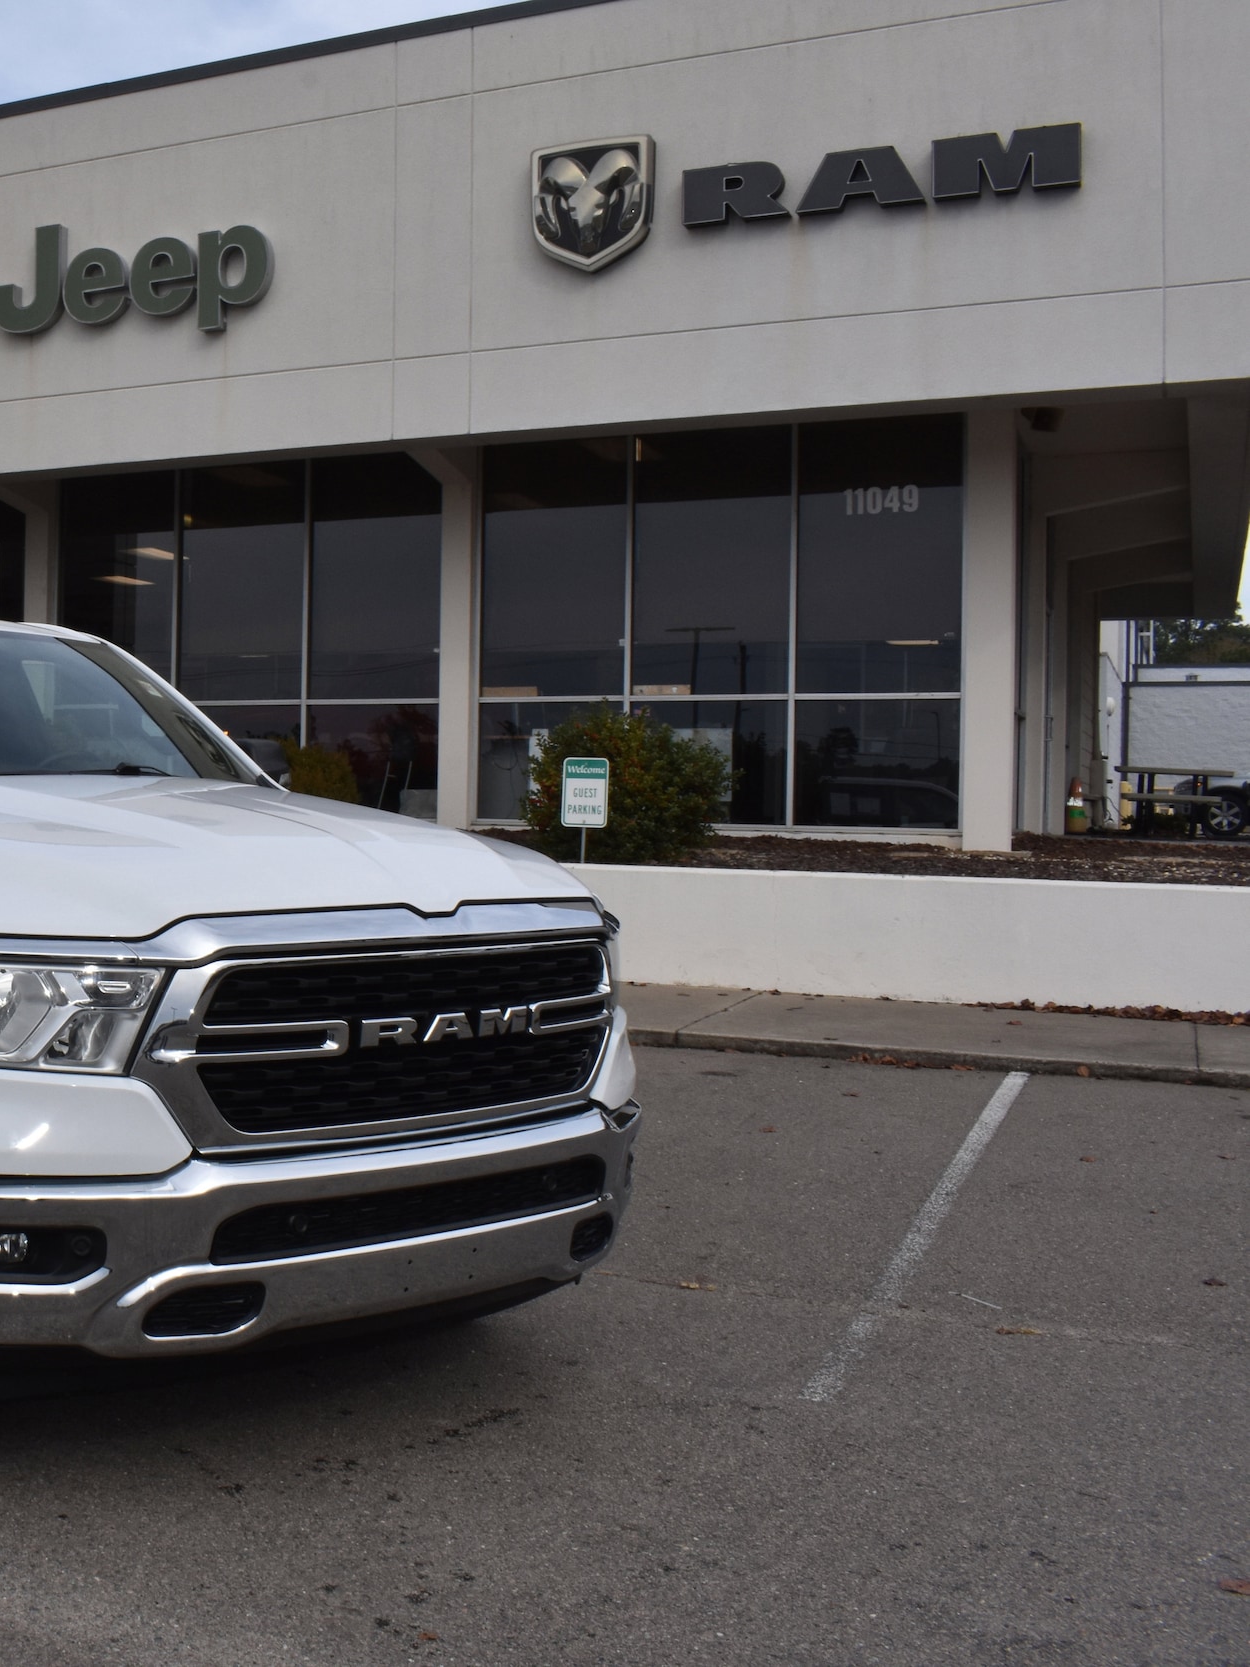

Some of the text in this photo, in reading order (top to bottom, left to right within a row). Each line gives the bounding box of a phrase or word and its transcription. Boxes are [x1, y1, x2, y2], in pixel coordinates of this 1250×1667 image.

[682, 122, 1082, 228] RAM
[843, 484, 919, 516] 11049
[567, 763, 606, 775] Welcome
[573, 787, 597, 798] GUEST
[567, 804, 602, 815] PARKING
[359, 1005, 528, 1048] RAM
